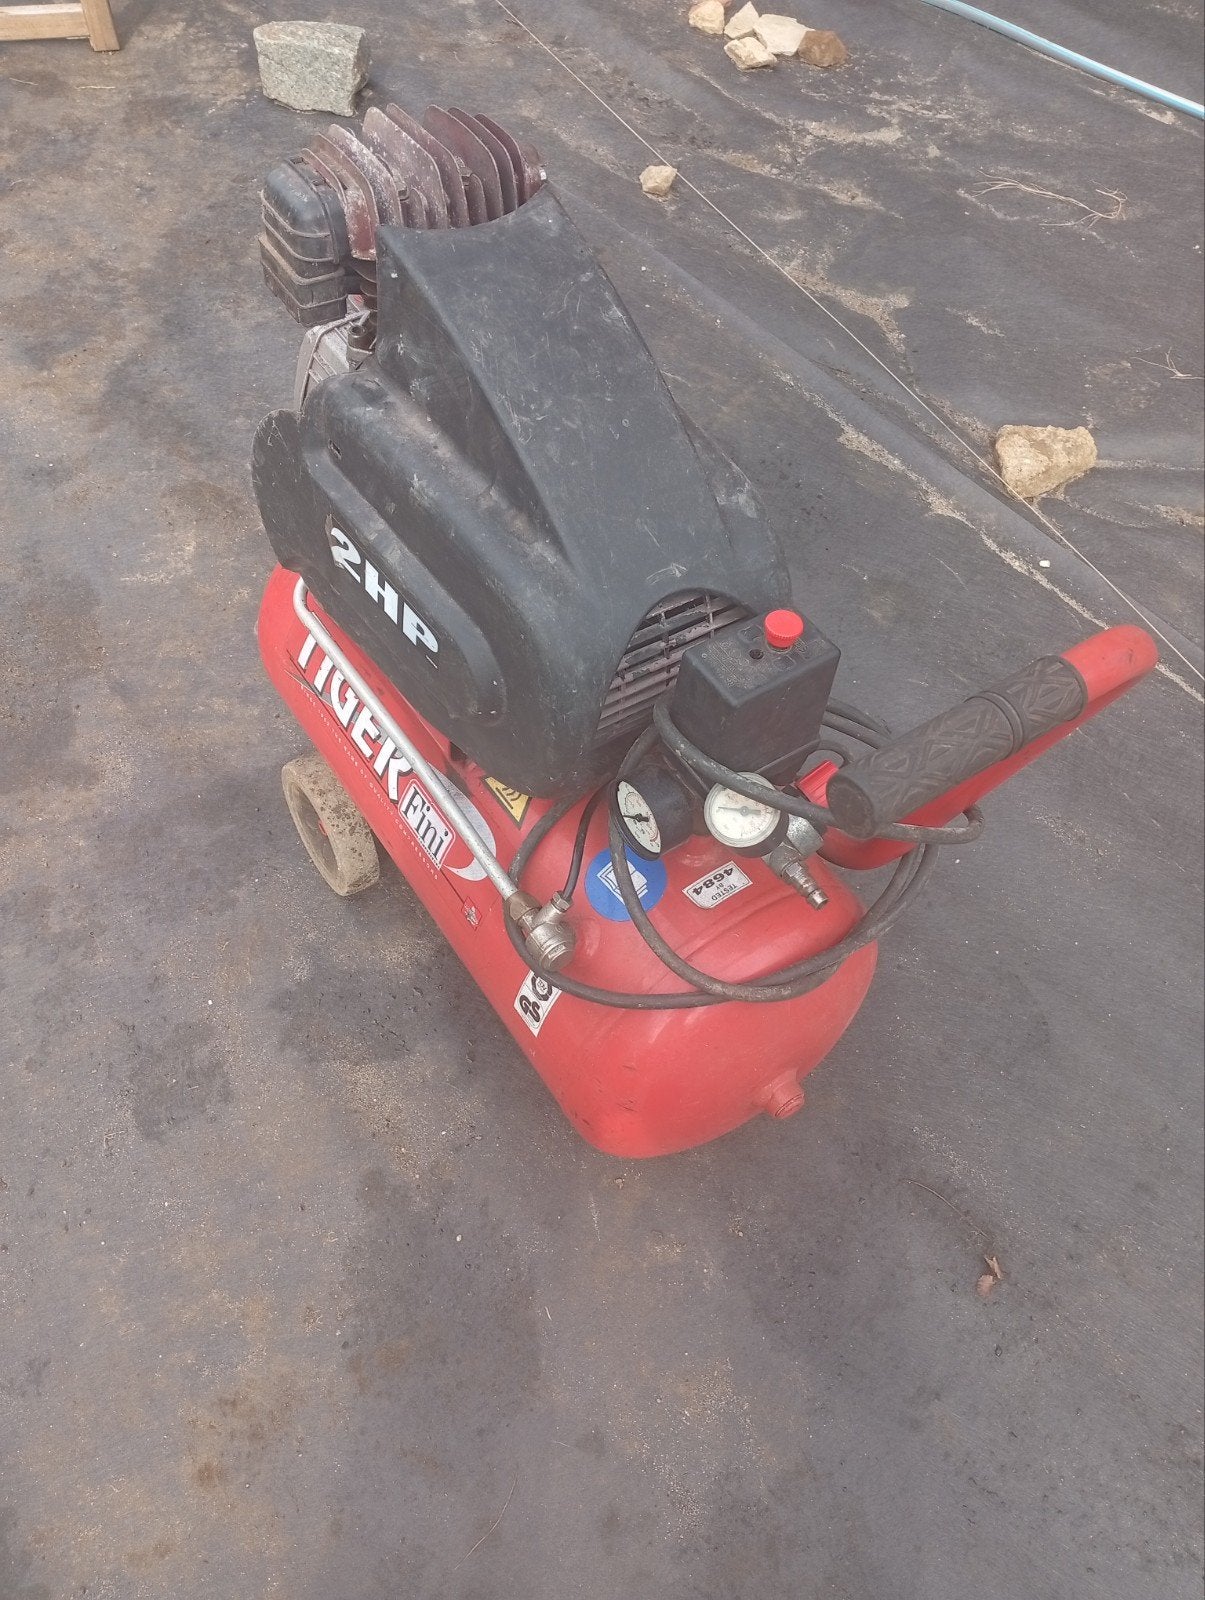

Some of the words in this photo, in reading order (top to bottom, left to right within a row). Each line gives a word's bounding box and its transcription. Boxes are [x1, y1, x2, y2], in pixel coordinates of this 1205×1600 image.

[330, 527, 439, 653] 2HP
[402, 785, 449, 861] Fini
[692, 867, 734, 896] 4684
[711, 883, 738, 901] TESTED
[715, 882, 725, 891] BY
[519, 994, 541, 1023] GS
